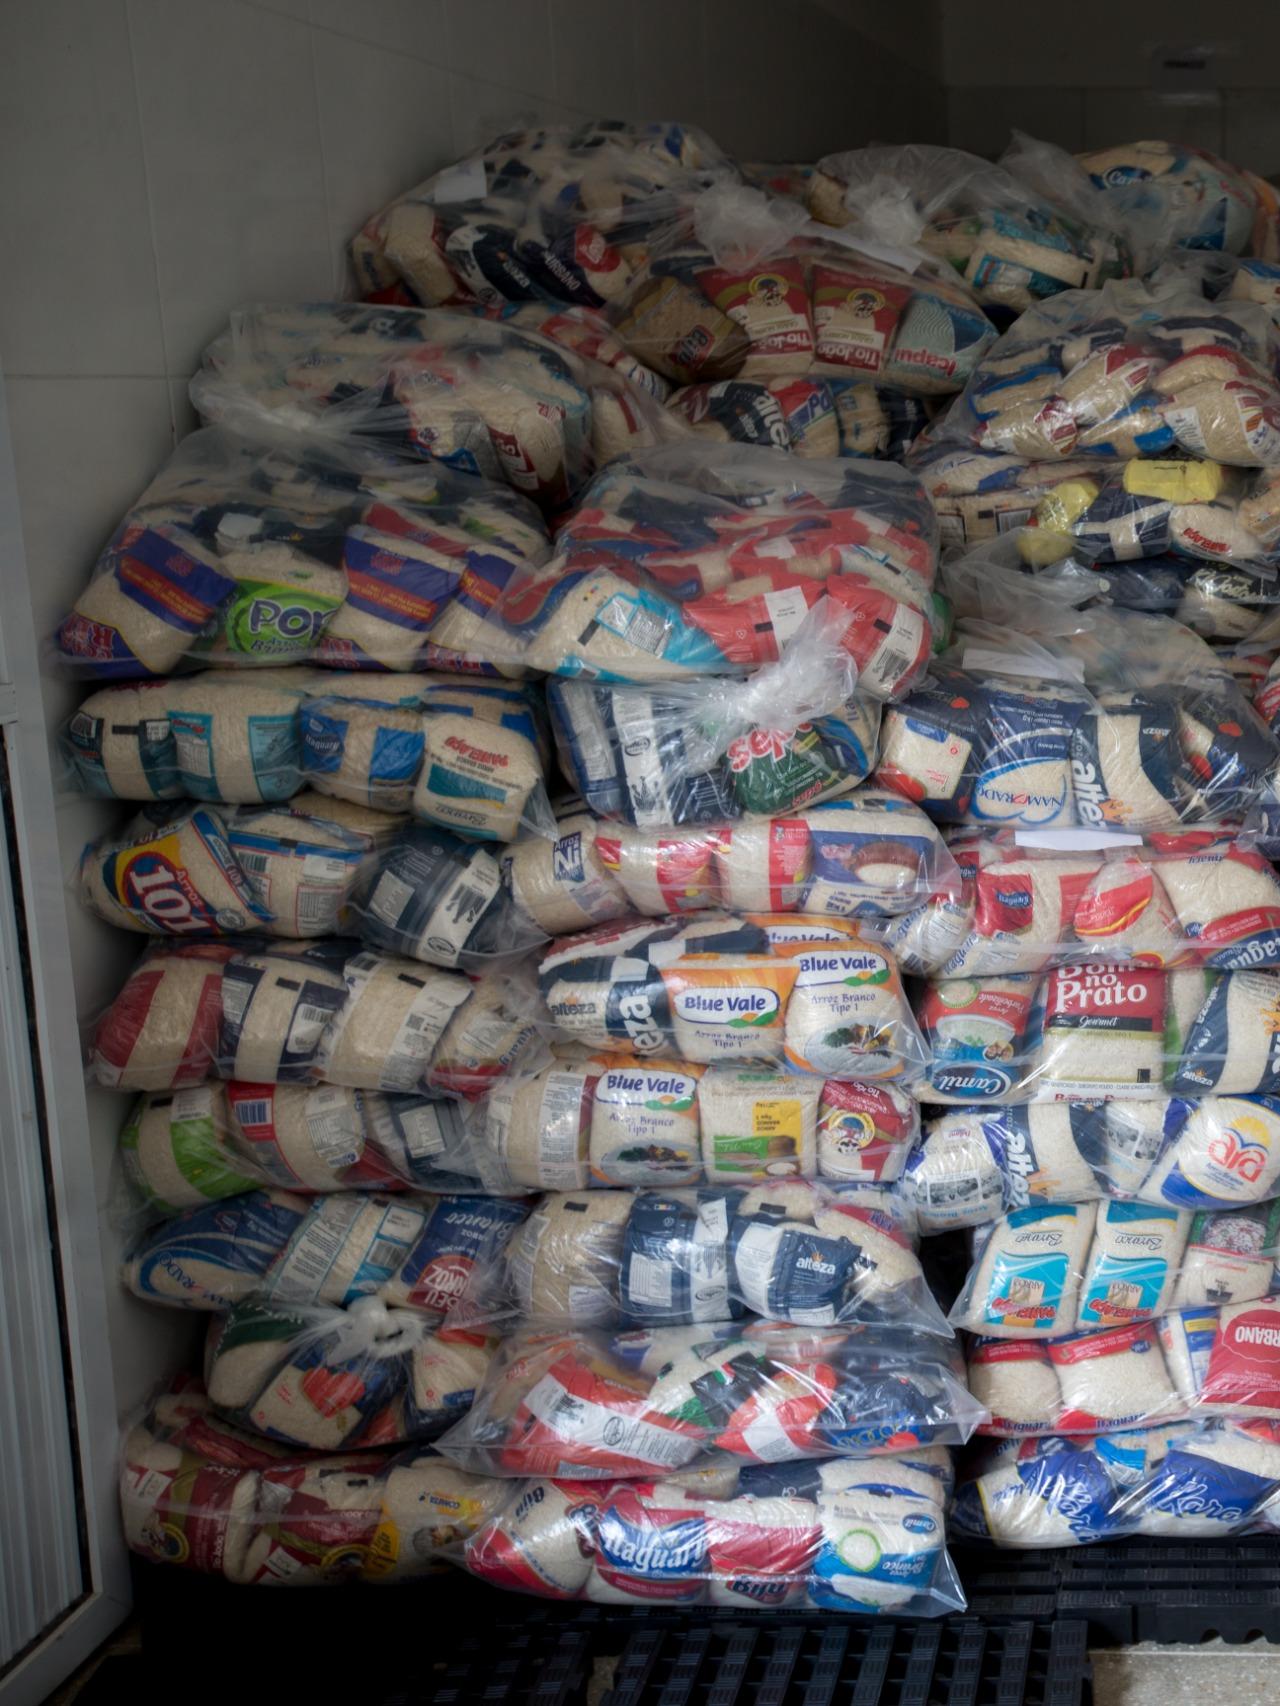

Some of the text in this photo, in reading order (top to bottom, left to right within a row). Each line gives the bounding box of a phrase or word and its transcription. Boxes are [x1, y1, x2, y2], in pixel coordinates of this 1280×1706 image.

[818, 342, 880, 367] Tio João
[176, 869, 206, 909] Arroz
[128, 863, 212, 934] 101
[800, 954, 878, 972] Blue Vale
[1086, 975, 1118, 995] no
[684, 995, 767, 1012] Blue Vale
[811, 991, 877, 1004] Arroz Branco
[1055, 978, 1148, 1012] Prato
[829, 1002, 850, 1013] Tipo
[1078, 1014, 1120, 1029] Gourmet
[712, 1037, 736, 1050] Tipo
[606, 1074, 644, 1091] Blue
[646, 1076, 686, 1094] Vale
[938, 1064, 1006, 1093] Camil
[627, 1124, 648, 1136] Tipo
[640, 1116, 676, 1128] Branco
[1114, 1233, 1163, 1251] Branco
[795, 1255, 836, 1275] alteza
